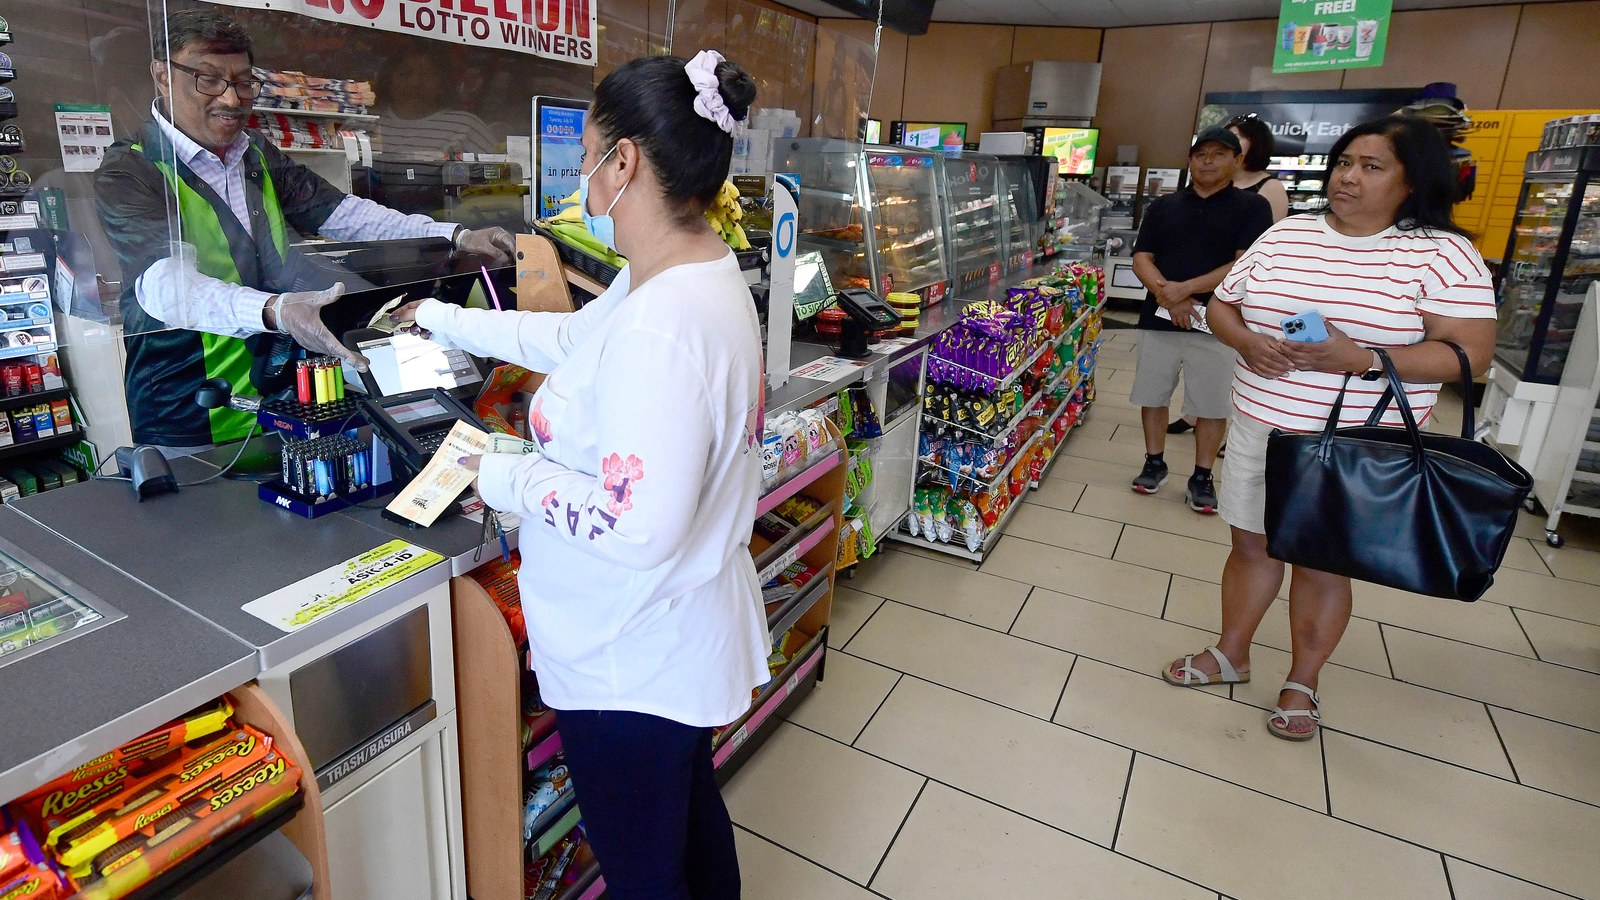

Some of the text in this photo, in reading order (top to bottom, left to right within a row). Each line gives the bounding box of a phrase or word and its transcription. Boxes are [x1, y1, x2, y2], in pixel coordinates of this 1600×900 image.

[1314, 0, 1356, 15] FREE!
[399, 3, 490, 40] LOTTO
[500, 21, 593, 60] WINNERS
[1318, 121, 1355, 136] Eat
[1466, 121, 1500, 129] azon
[909, 133, 920, 146] $1
[548, 166, 557, 177] in
[544, 208, 561, 218] last
[273, 419, 293, 431] NEON
[522, 440, 534, 454] 20
[180, 735, 256, 784] Reese's
[326, 721, 412, 784] TRASH/BASURA
[41, 765, 128, 818] Reese's
